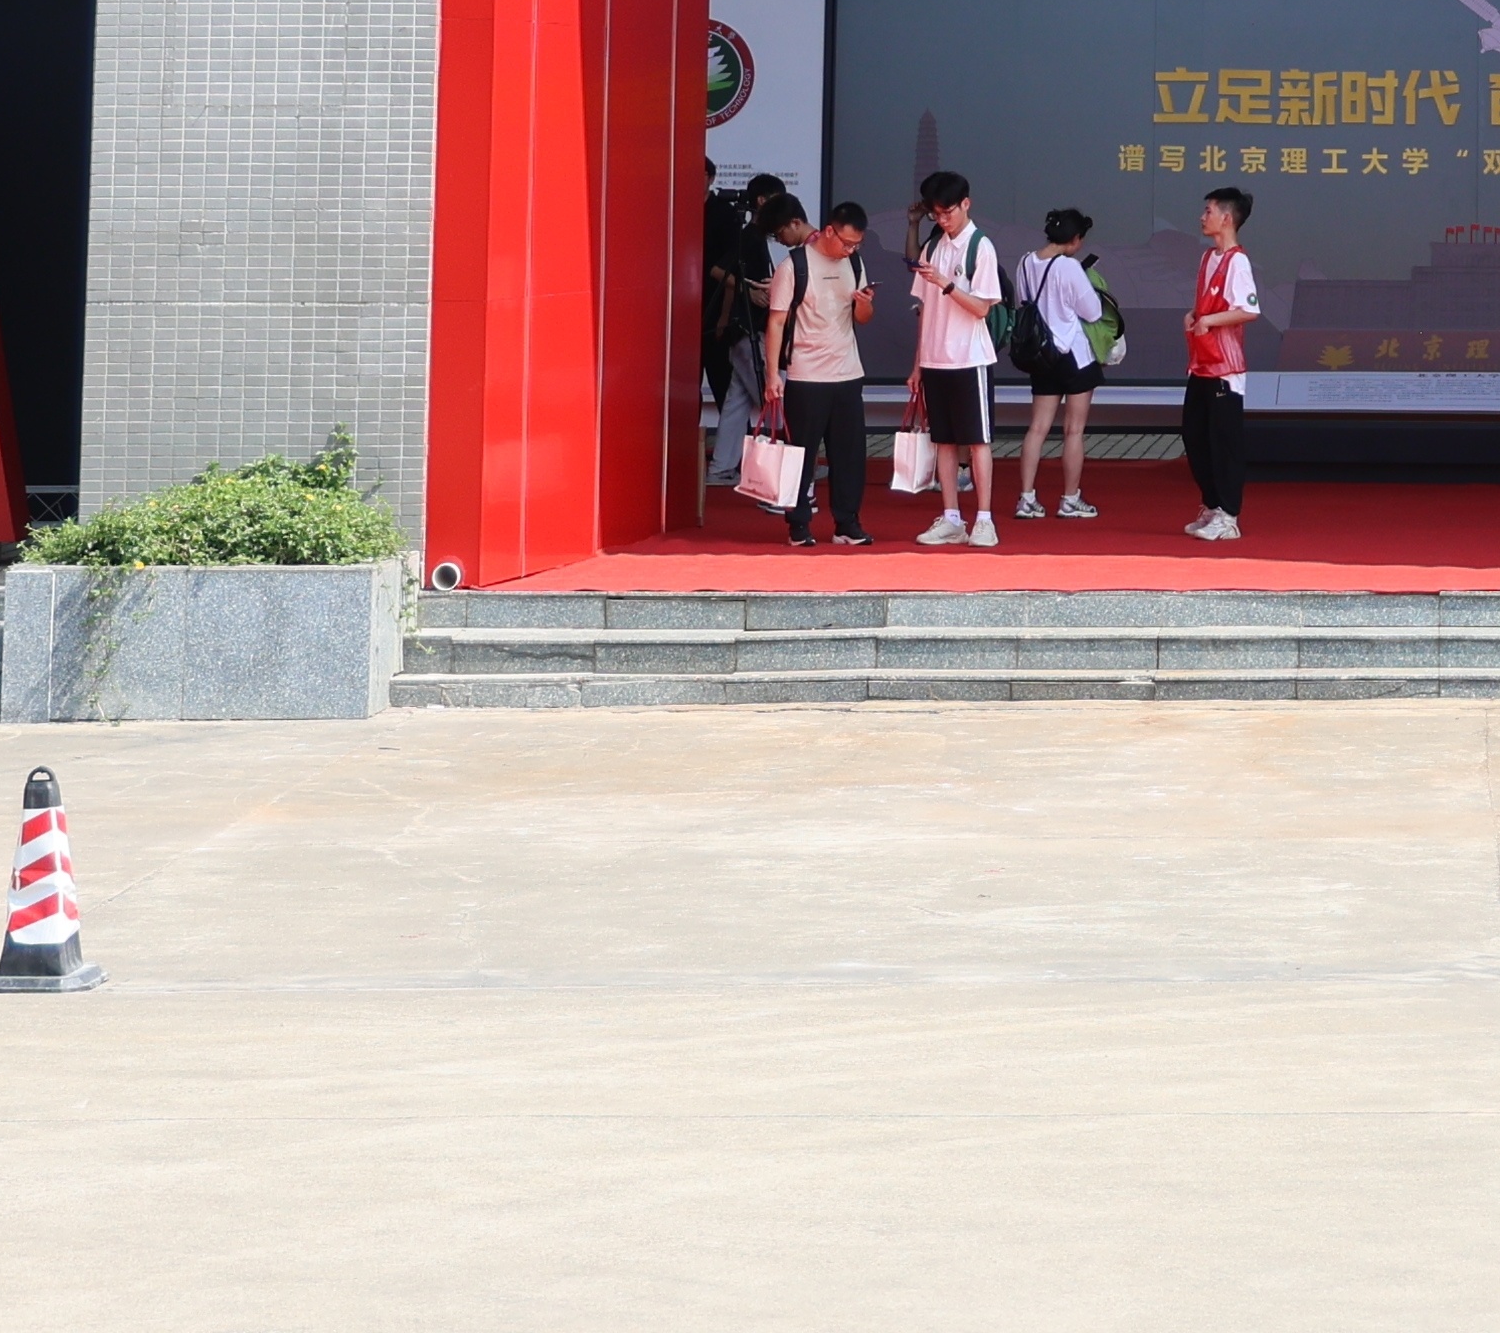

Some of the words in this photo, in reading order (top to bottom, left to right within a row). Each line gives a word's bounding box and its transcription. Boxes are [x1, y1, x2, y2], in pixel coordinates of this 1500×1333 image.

[720, 68, 752, 121] TECHNOLOGY
[1153, 67, 1461, 126] 立足新时代
